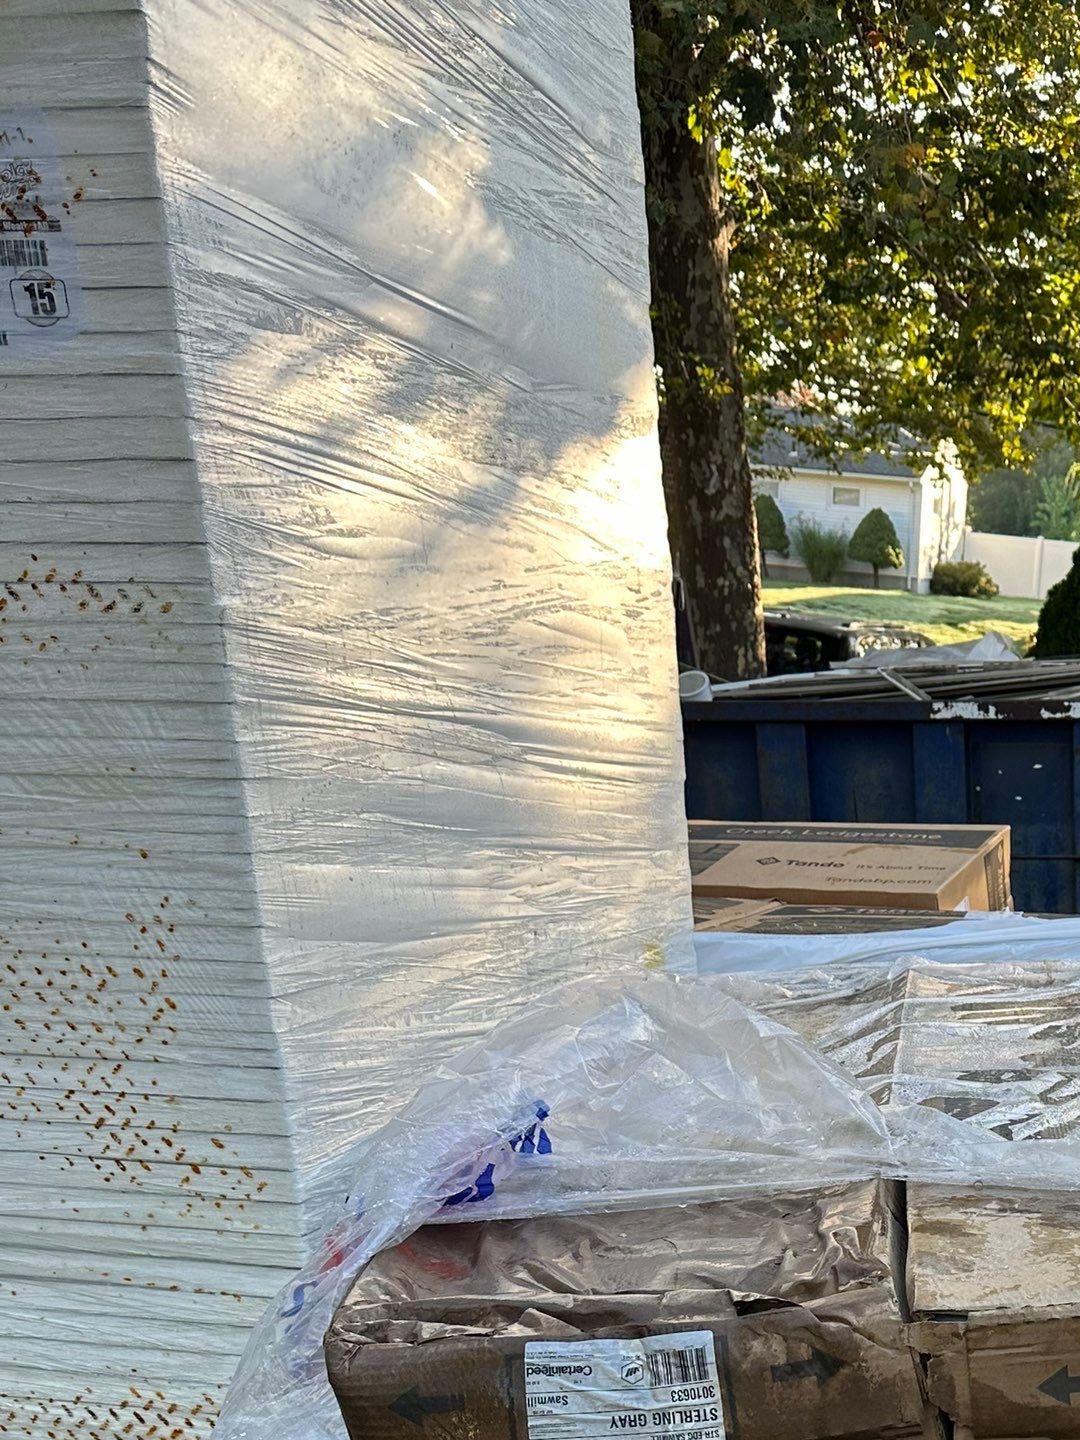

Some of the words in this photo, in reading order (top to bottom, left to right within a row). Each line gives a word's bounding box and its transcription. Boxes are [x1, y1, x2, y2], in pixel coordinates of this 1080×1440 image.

[24, 282, 56, 316] 15
[726, 827, 794, 836] Creek
[801, 828, 942, 840] Ledgestone
[786, 859, 845, 868] Tando
[526, 1362, 592, 1375] CertainTeed
[671, 1385, 715, 1401] 3010633
[527, 1395, 568, 1407] Sawmill
[610, 1413, 647, 1429] GRAY
[654, 1408, 718, 1426] STERLING
